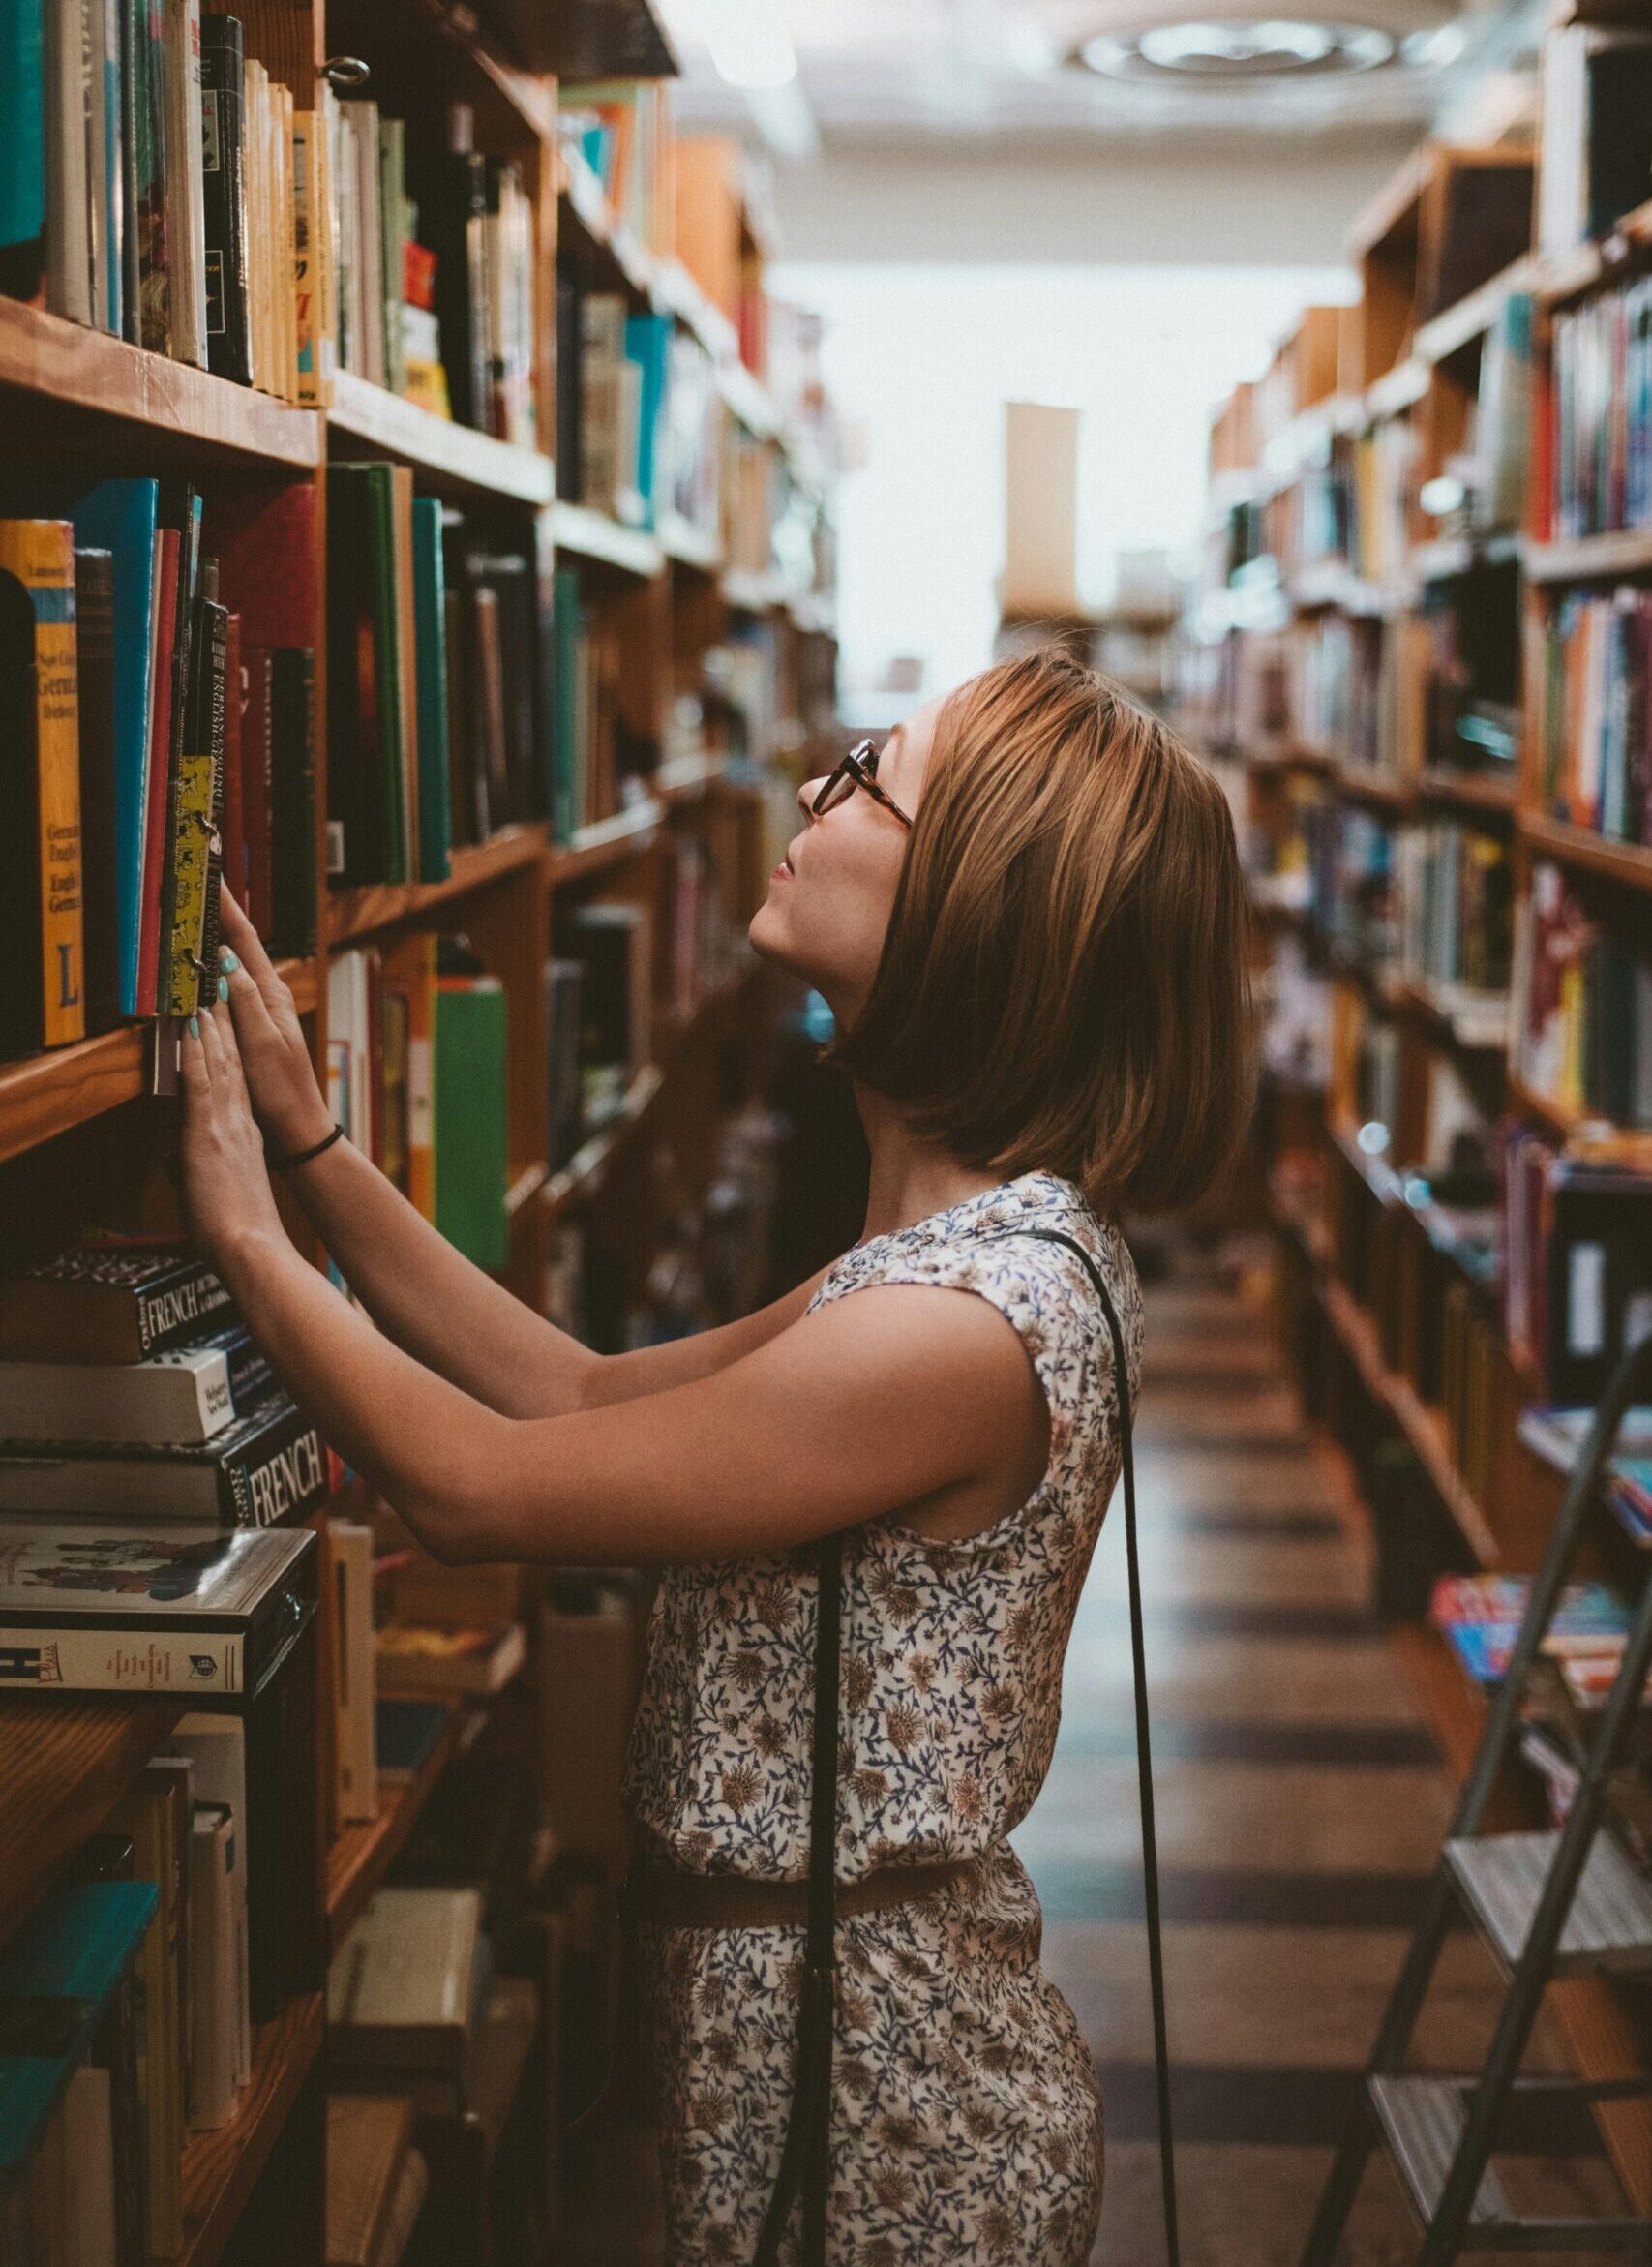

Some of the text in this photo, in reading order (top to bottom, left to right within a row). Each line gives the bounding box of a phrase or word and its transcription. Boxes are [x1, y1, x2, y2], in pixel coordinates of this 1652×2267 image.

[58, 944, 78, 1008] L
[147, 1282, 198, 1338] FRENCH
[249, 1429, 323, 1529] FRENCH
